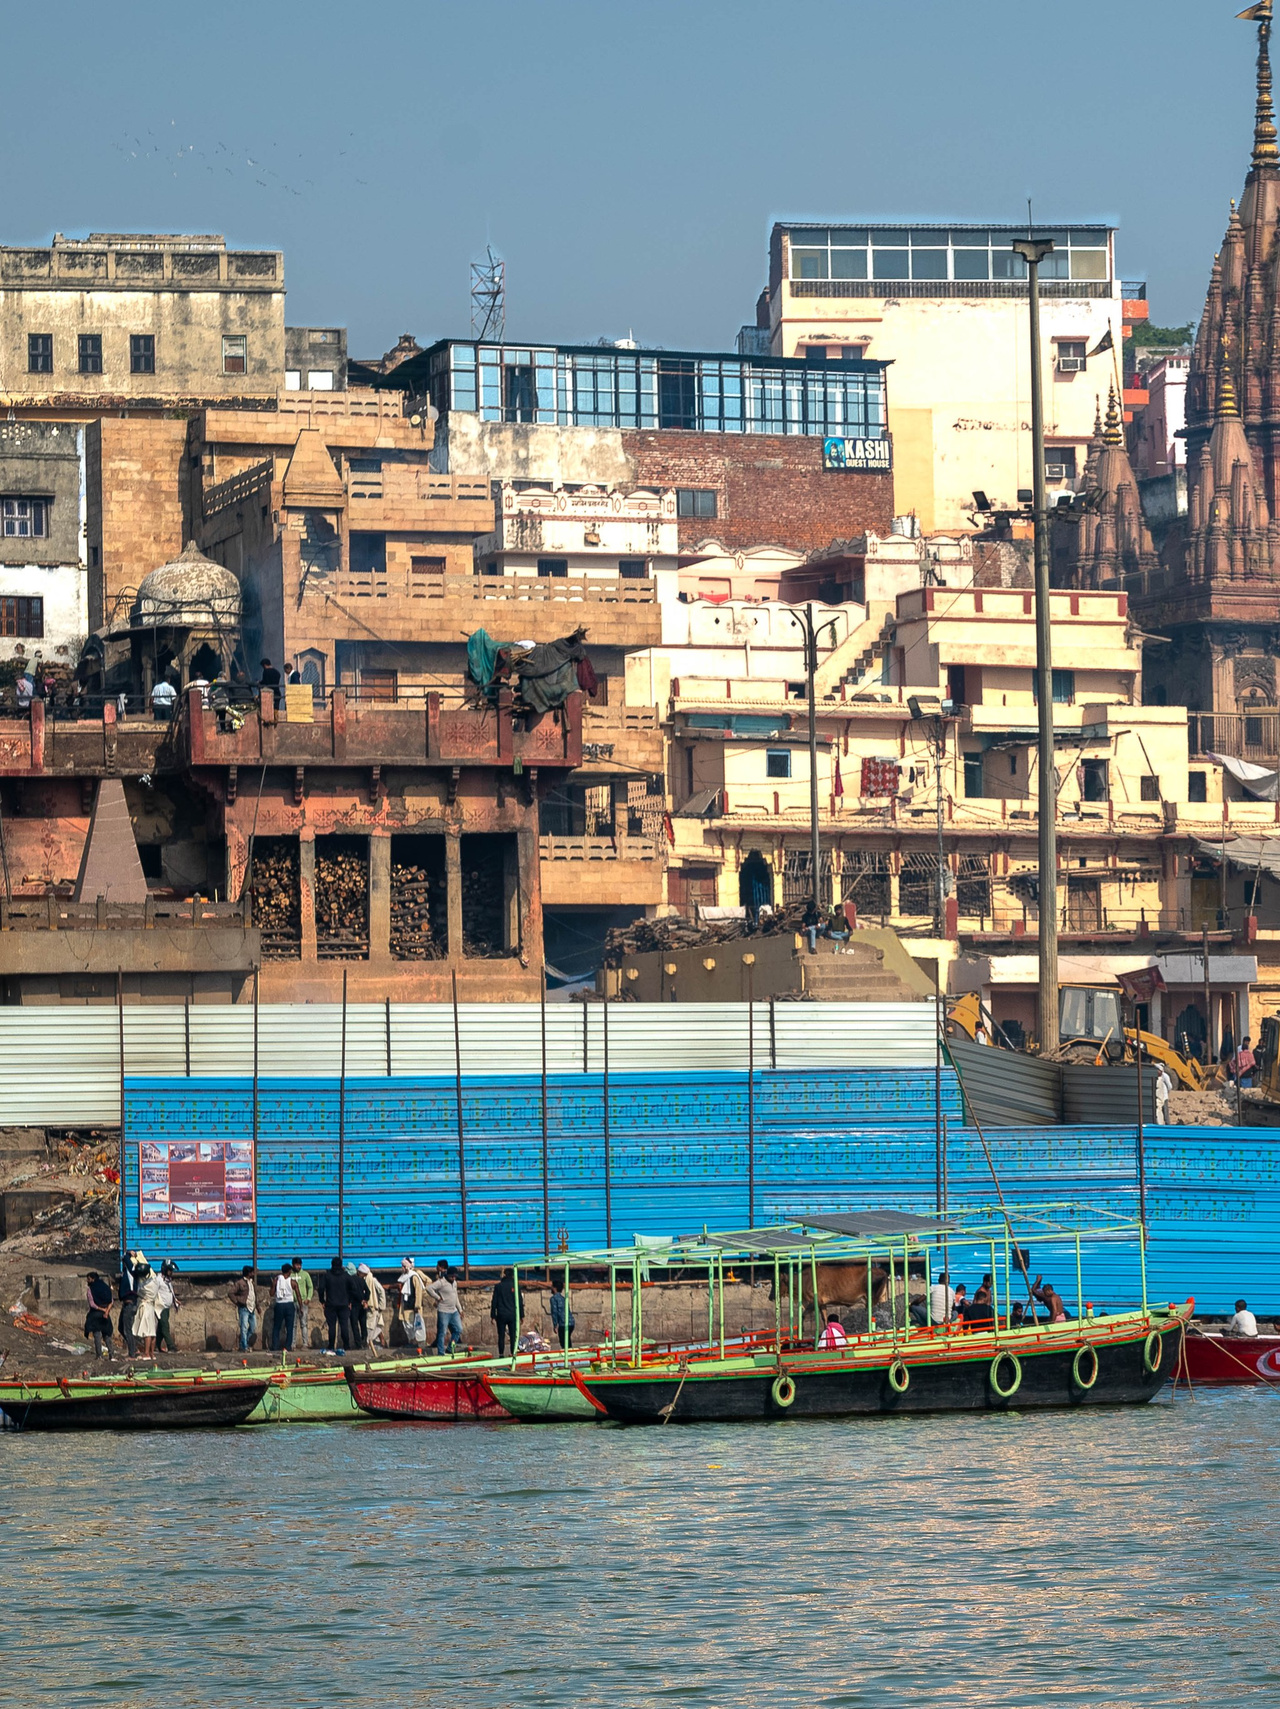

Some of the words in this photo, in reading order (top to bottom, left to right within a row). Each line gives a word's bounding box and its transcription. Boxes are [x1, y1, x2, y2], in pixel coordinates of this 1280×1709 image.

[844, 439, 890, 460] KASHI
[845, 459, 867, 468] GUEST
[867, 459, 890, 468] HOUSE
